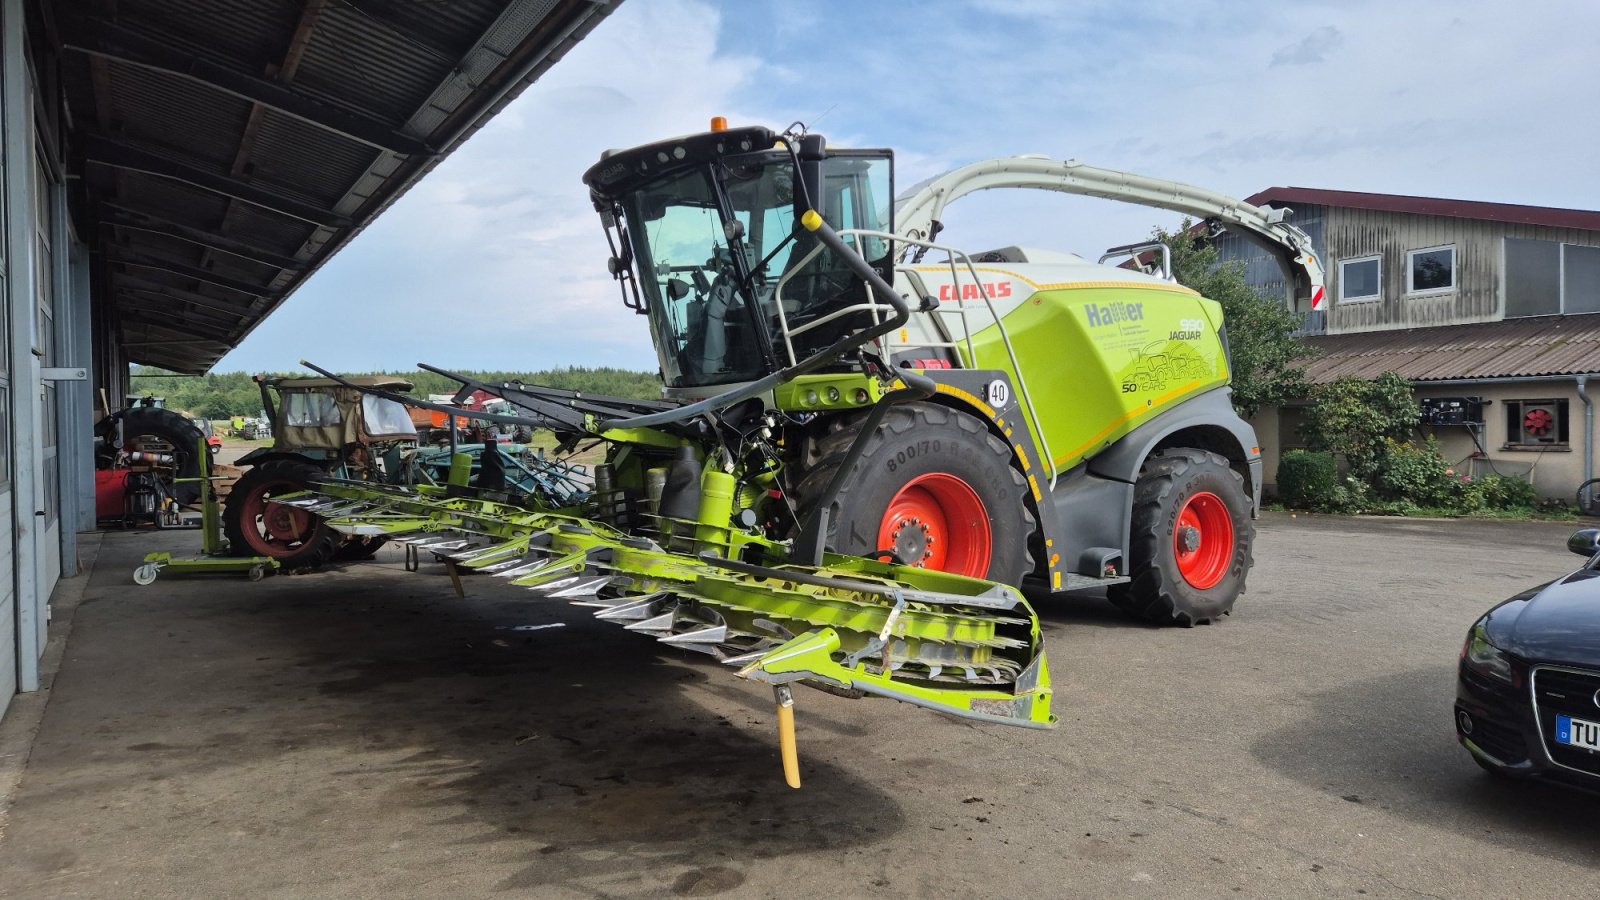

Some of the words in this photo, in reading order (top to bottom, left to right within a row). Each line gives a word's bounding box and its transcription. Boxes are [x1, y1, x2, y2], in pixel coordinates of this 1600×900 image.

[939, 282, 1011, 301] CLAAS
[1168, 330, 1201, 341] JAGUAR
[992, 384, 1005, 402] 40
[887, 440, 941, 473] 800/70
[1561, 731, 1567, 739] D
